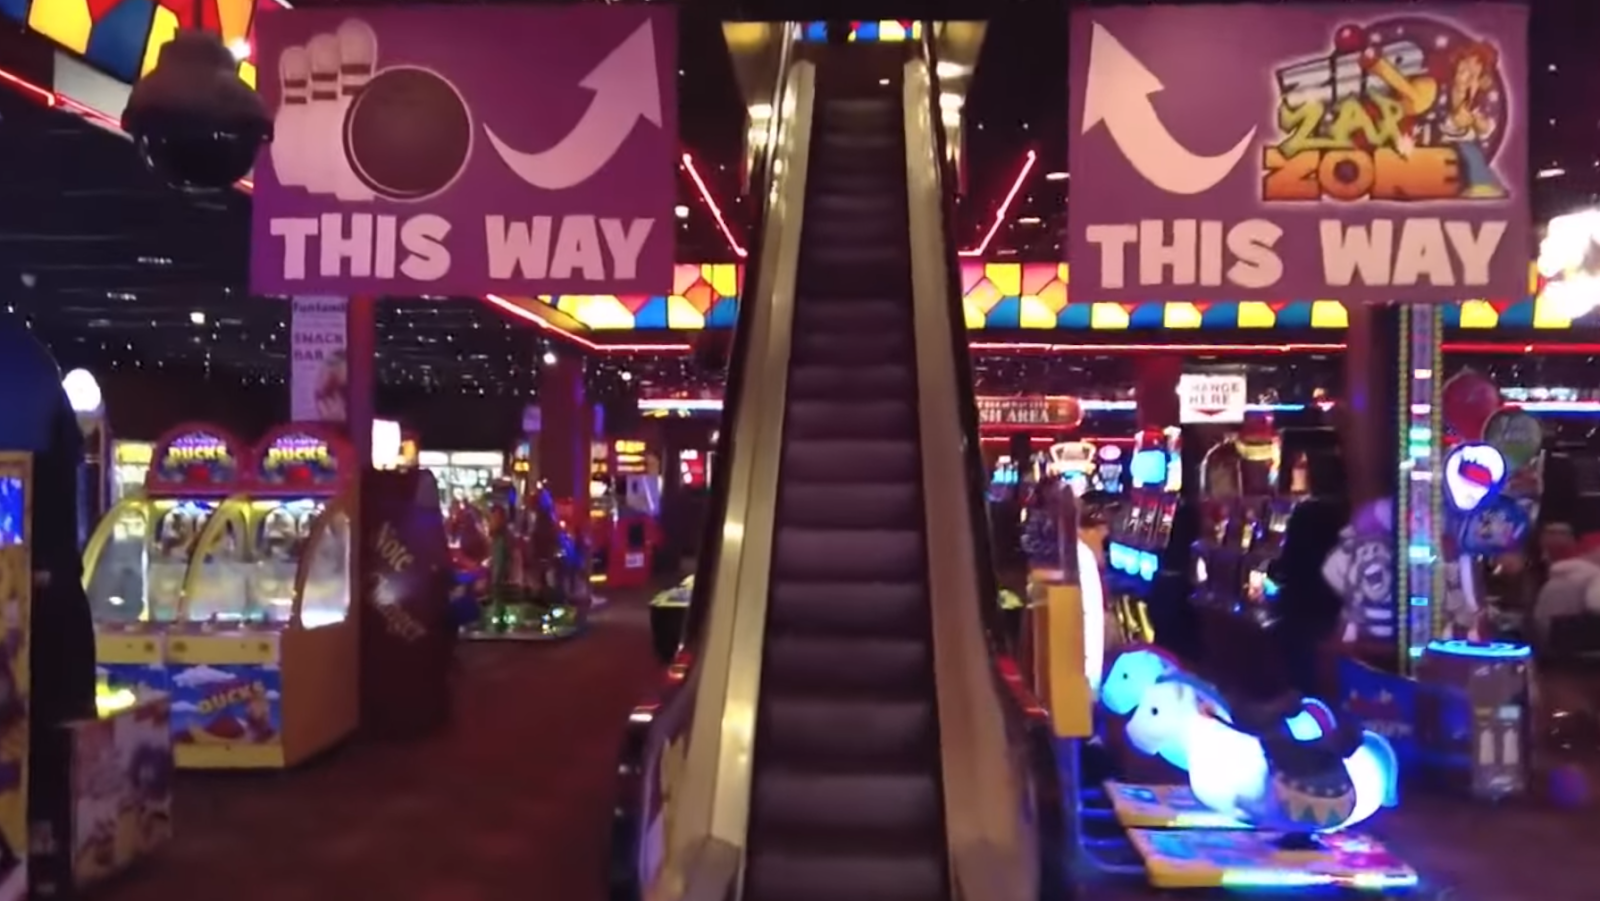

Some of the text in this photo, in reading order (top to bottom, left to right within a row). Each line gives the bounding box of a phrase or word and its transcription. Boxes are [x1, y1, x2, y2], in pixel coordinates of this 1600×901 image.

[1277, 94, 1408, 160] ZAP
[1262, 146, 1461, 201] ZONE
[270, 212, 656, 280] THIS WAY
[1086, 218, 1507, 288] THIS WAY
[294, 332, 343, 345] SNACK
[1183, 382, 1240, 393] HANGE
[1189, 394, 1230, 405] HERE
[1006, 408, 1050, 423] AREA
[168, 445, 227, 462] DUCKS
[268, 446, 328, 463] DUCKS
